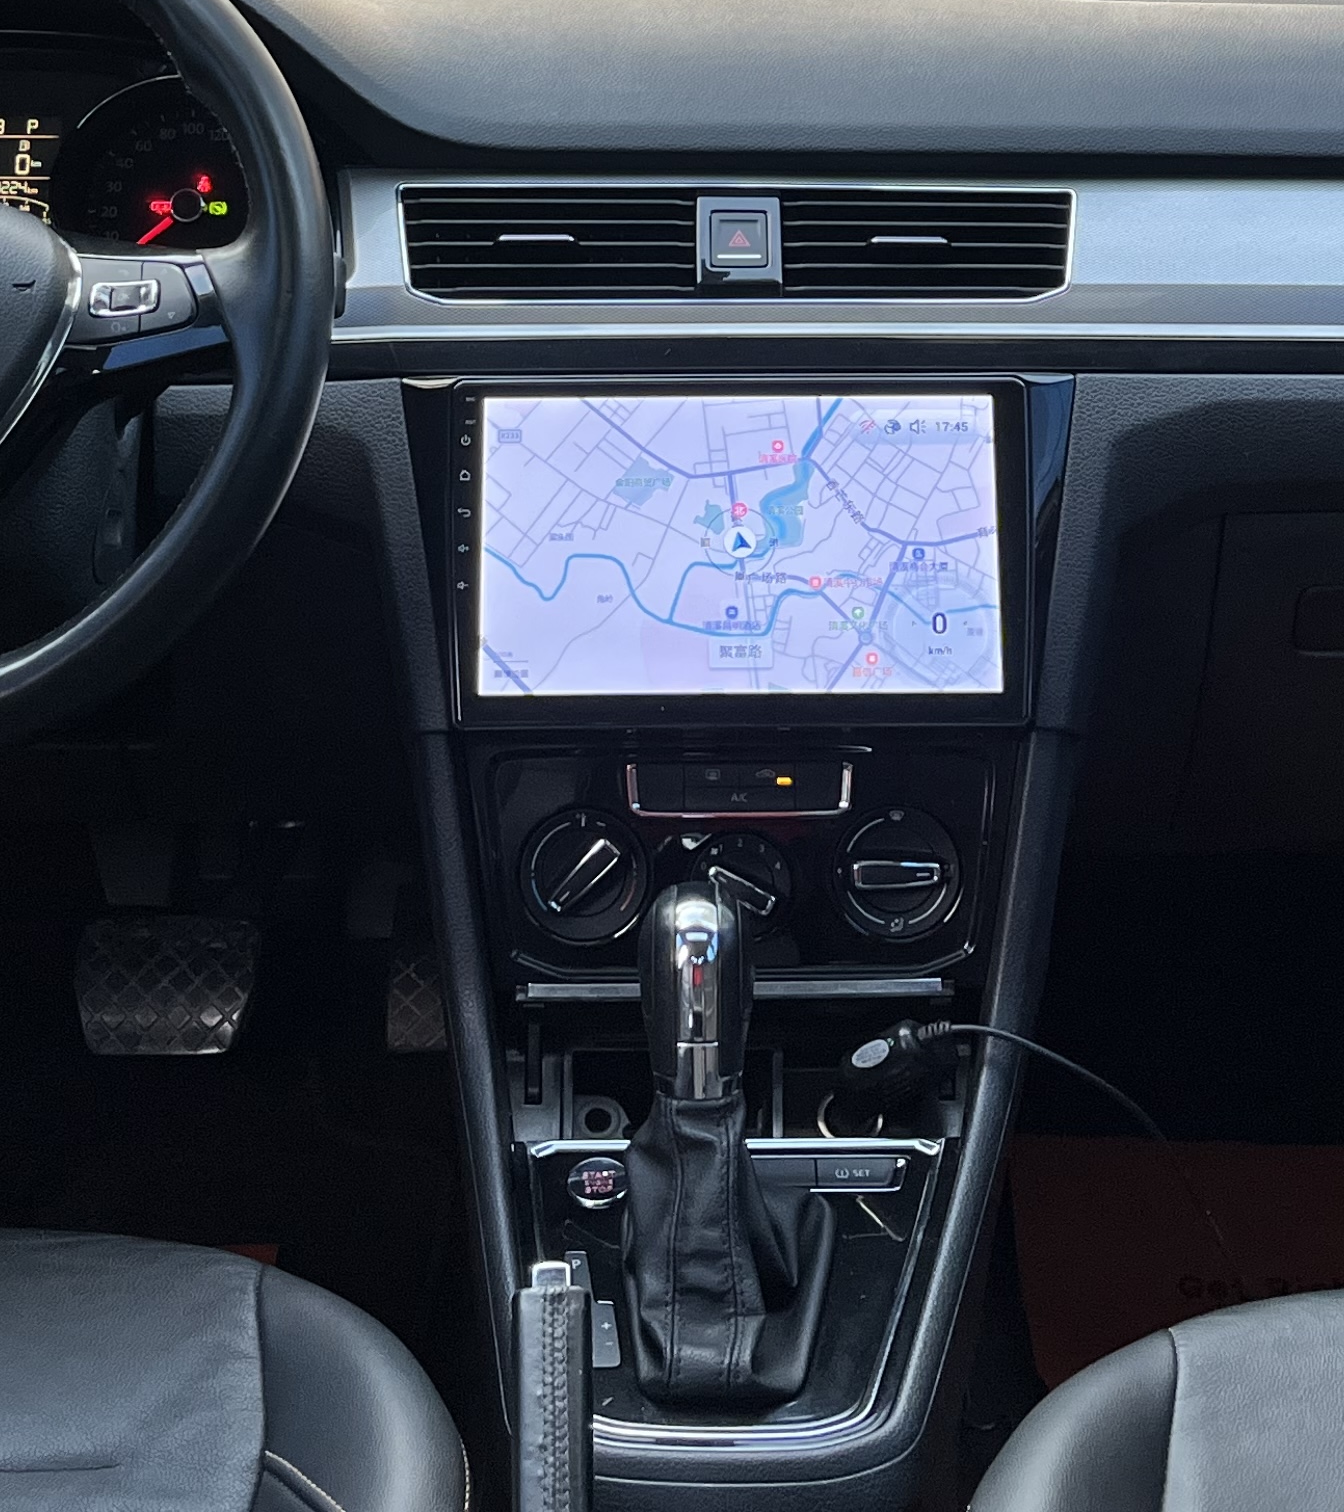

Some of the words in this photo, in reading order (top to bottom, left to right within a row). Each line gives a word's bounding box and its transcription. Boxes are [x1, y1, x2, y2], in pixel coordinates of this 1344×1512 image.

[27, 119, 39, 134] P
[159, 128, 176, 140] 80
[100, 206, 118, 218] 20
[935, 421, 969, 432] 17:45
[931, 612, 948, 634] 0
[719, 644, 763, 659] 聚富路
[928, 646, 953, 655] km/h
[730, 792, 748, 803] A/C
[852, 1169, 870, 1178] SET
[584, 1185, 613, 1194] STOP
[571, 1258, 582, 1270] P
